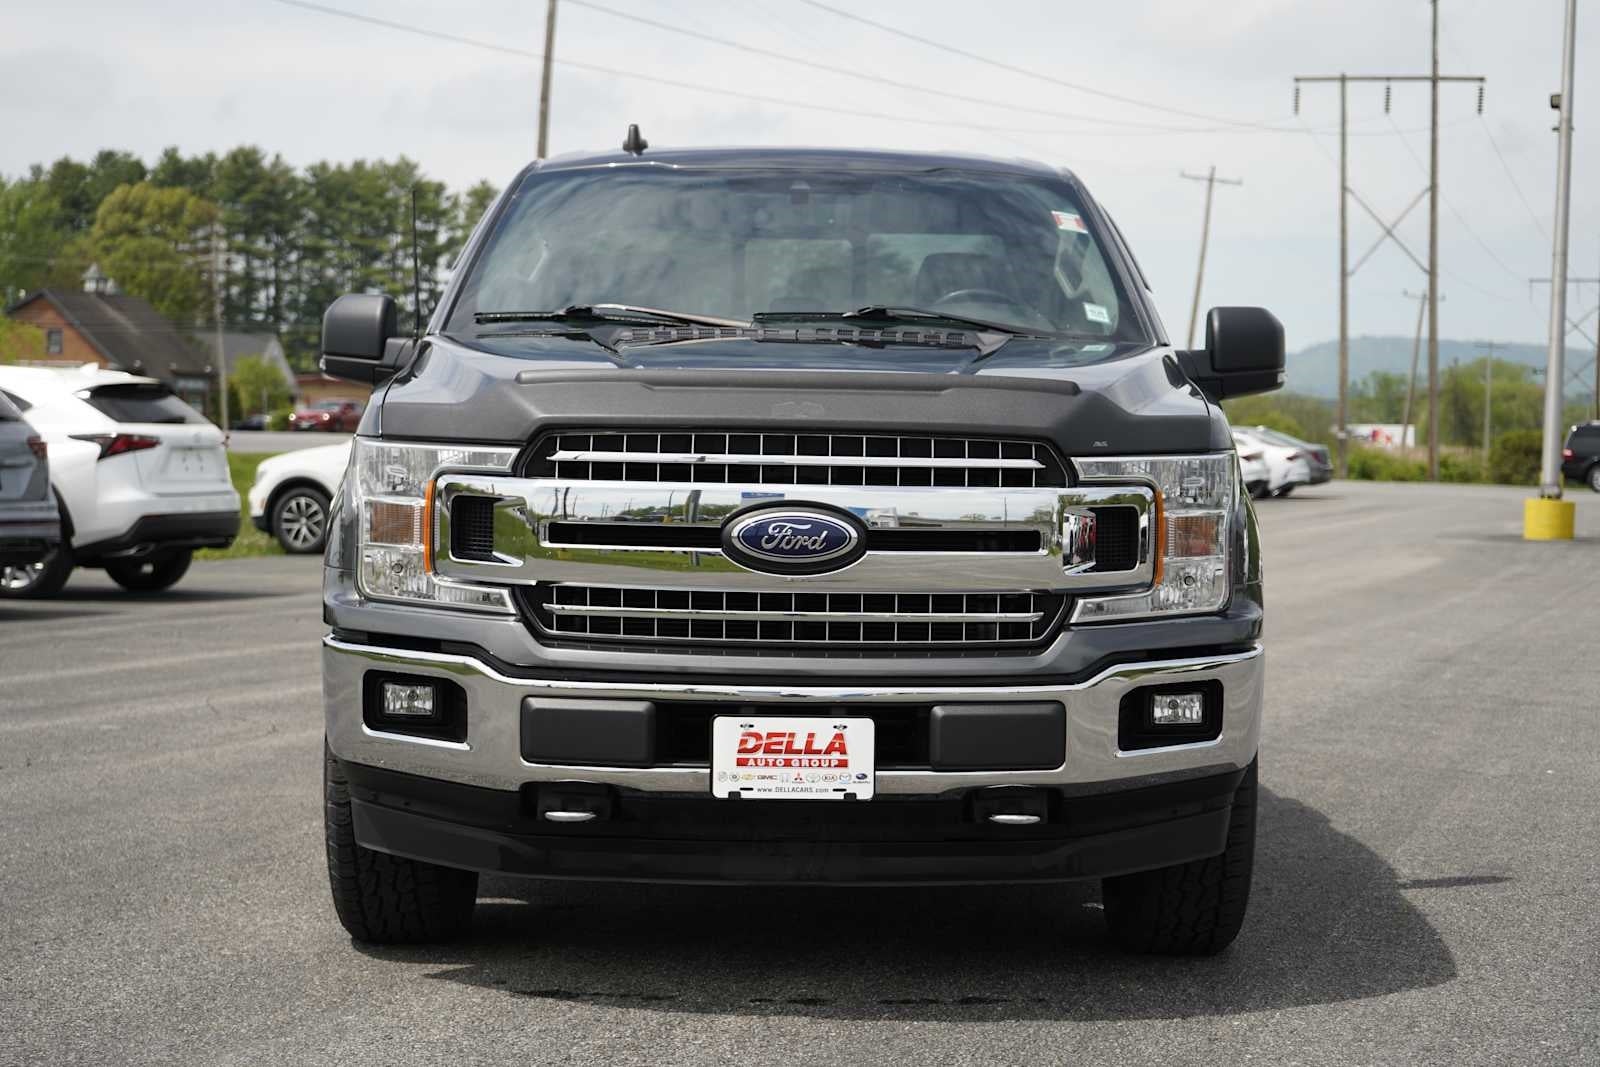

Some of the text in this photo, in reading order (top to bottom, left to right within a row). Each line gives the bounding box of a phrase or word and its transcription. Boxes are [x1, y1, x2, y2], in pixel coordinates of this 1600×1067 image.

[760, 522, 829, 550] Ford
[737, 732, 847, 755] DELLA
[747, 758, 839, 767] AUTO GROUP
